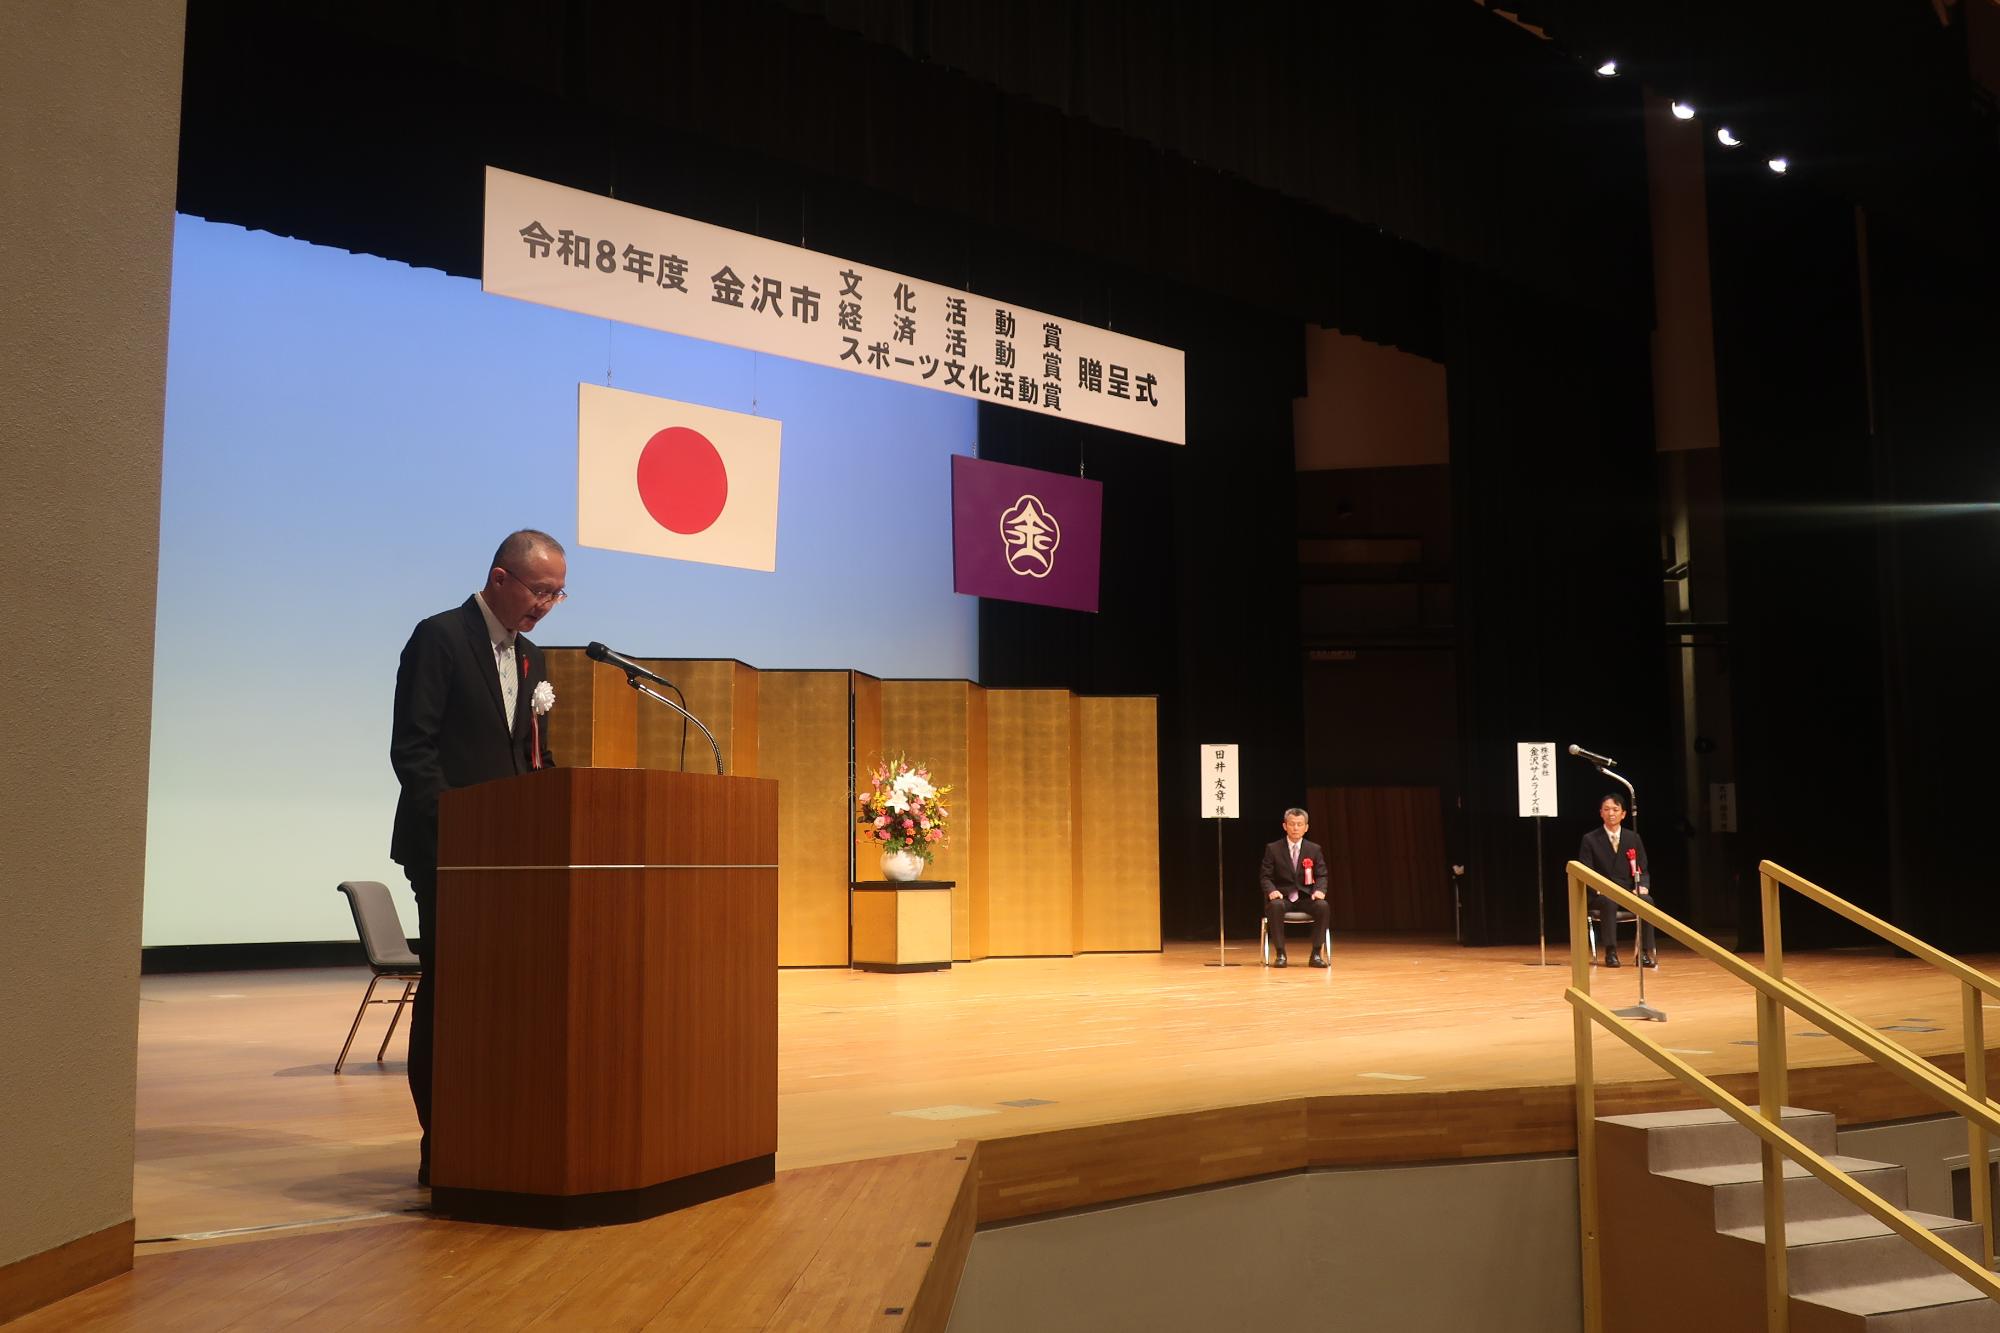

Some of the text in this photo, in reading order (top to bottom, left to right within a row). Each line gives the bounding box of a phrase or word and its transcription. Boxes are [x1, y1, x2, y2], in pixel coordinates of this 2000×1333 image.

[518, 220, 821, 324] 令和8年度 金沢市
[839, 335, 1062, 411] スポーツ文化活動賞
[1077, 356, 1158, 407] 贈呈式
